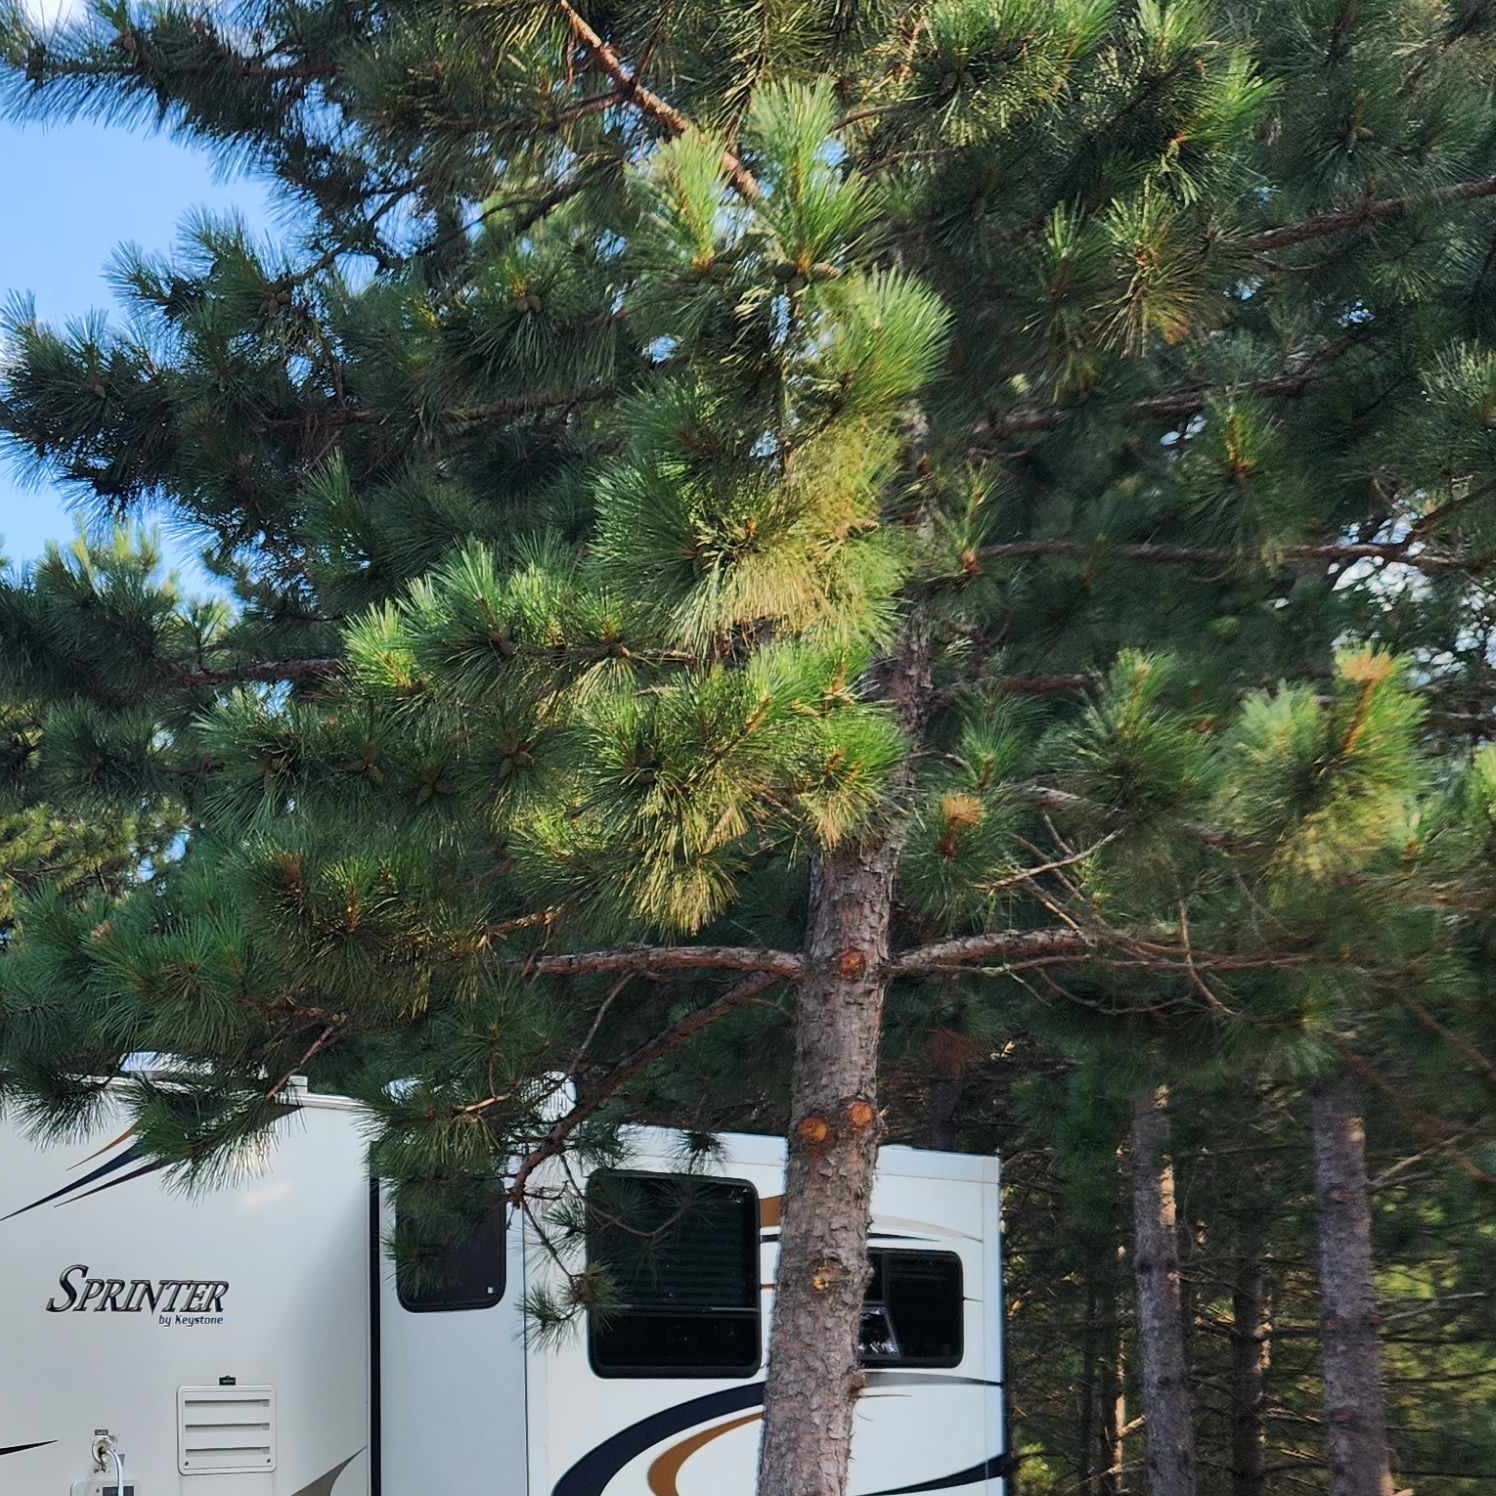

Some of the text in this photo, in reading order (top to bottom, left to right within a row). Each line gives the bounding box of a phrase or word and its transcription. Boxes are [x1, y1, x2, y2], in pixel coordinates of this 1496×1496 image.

[45, 1264, 229, 1315] SPRINTER
[158, 1315, 224, 1327] by Keystone
